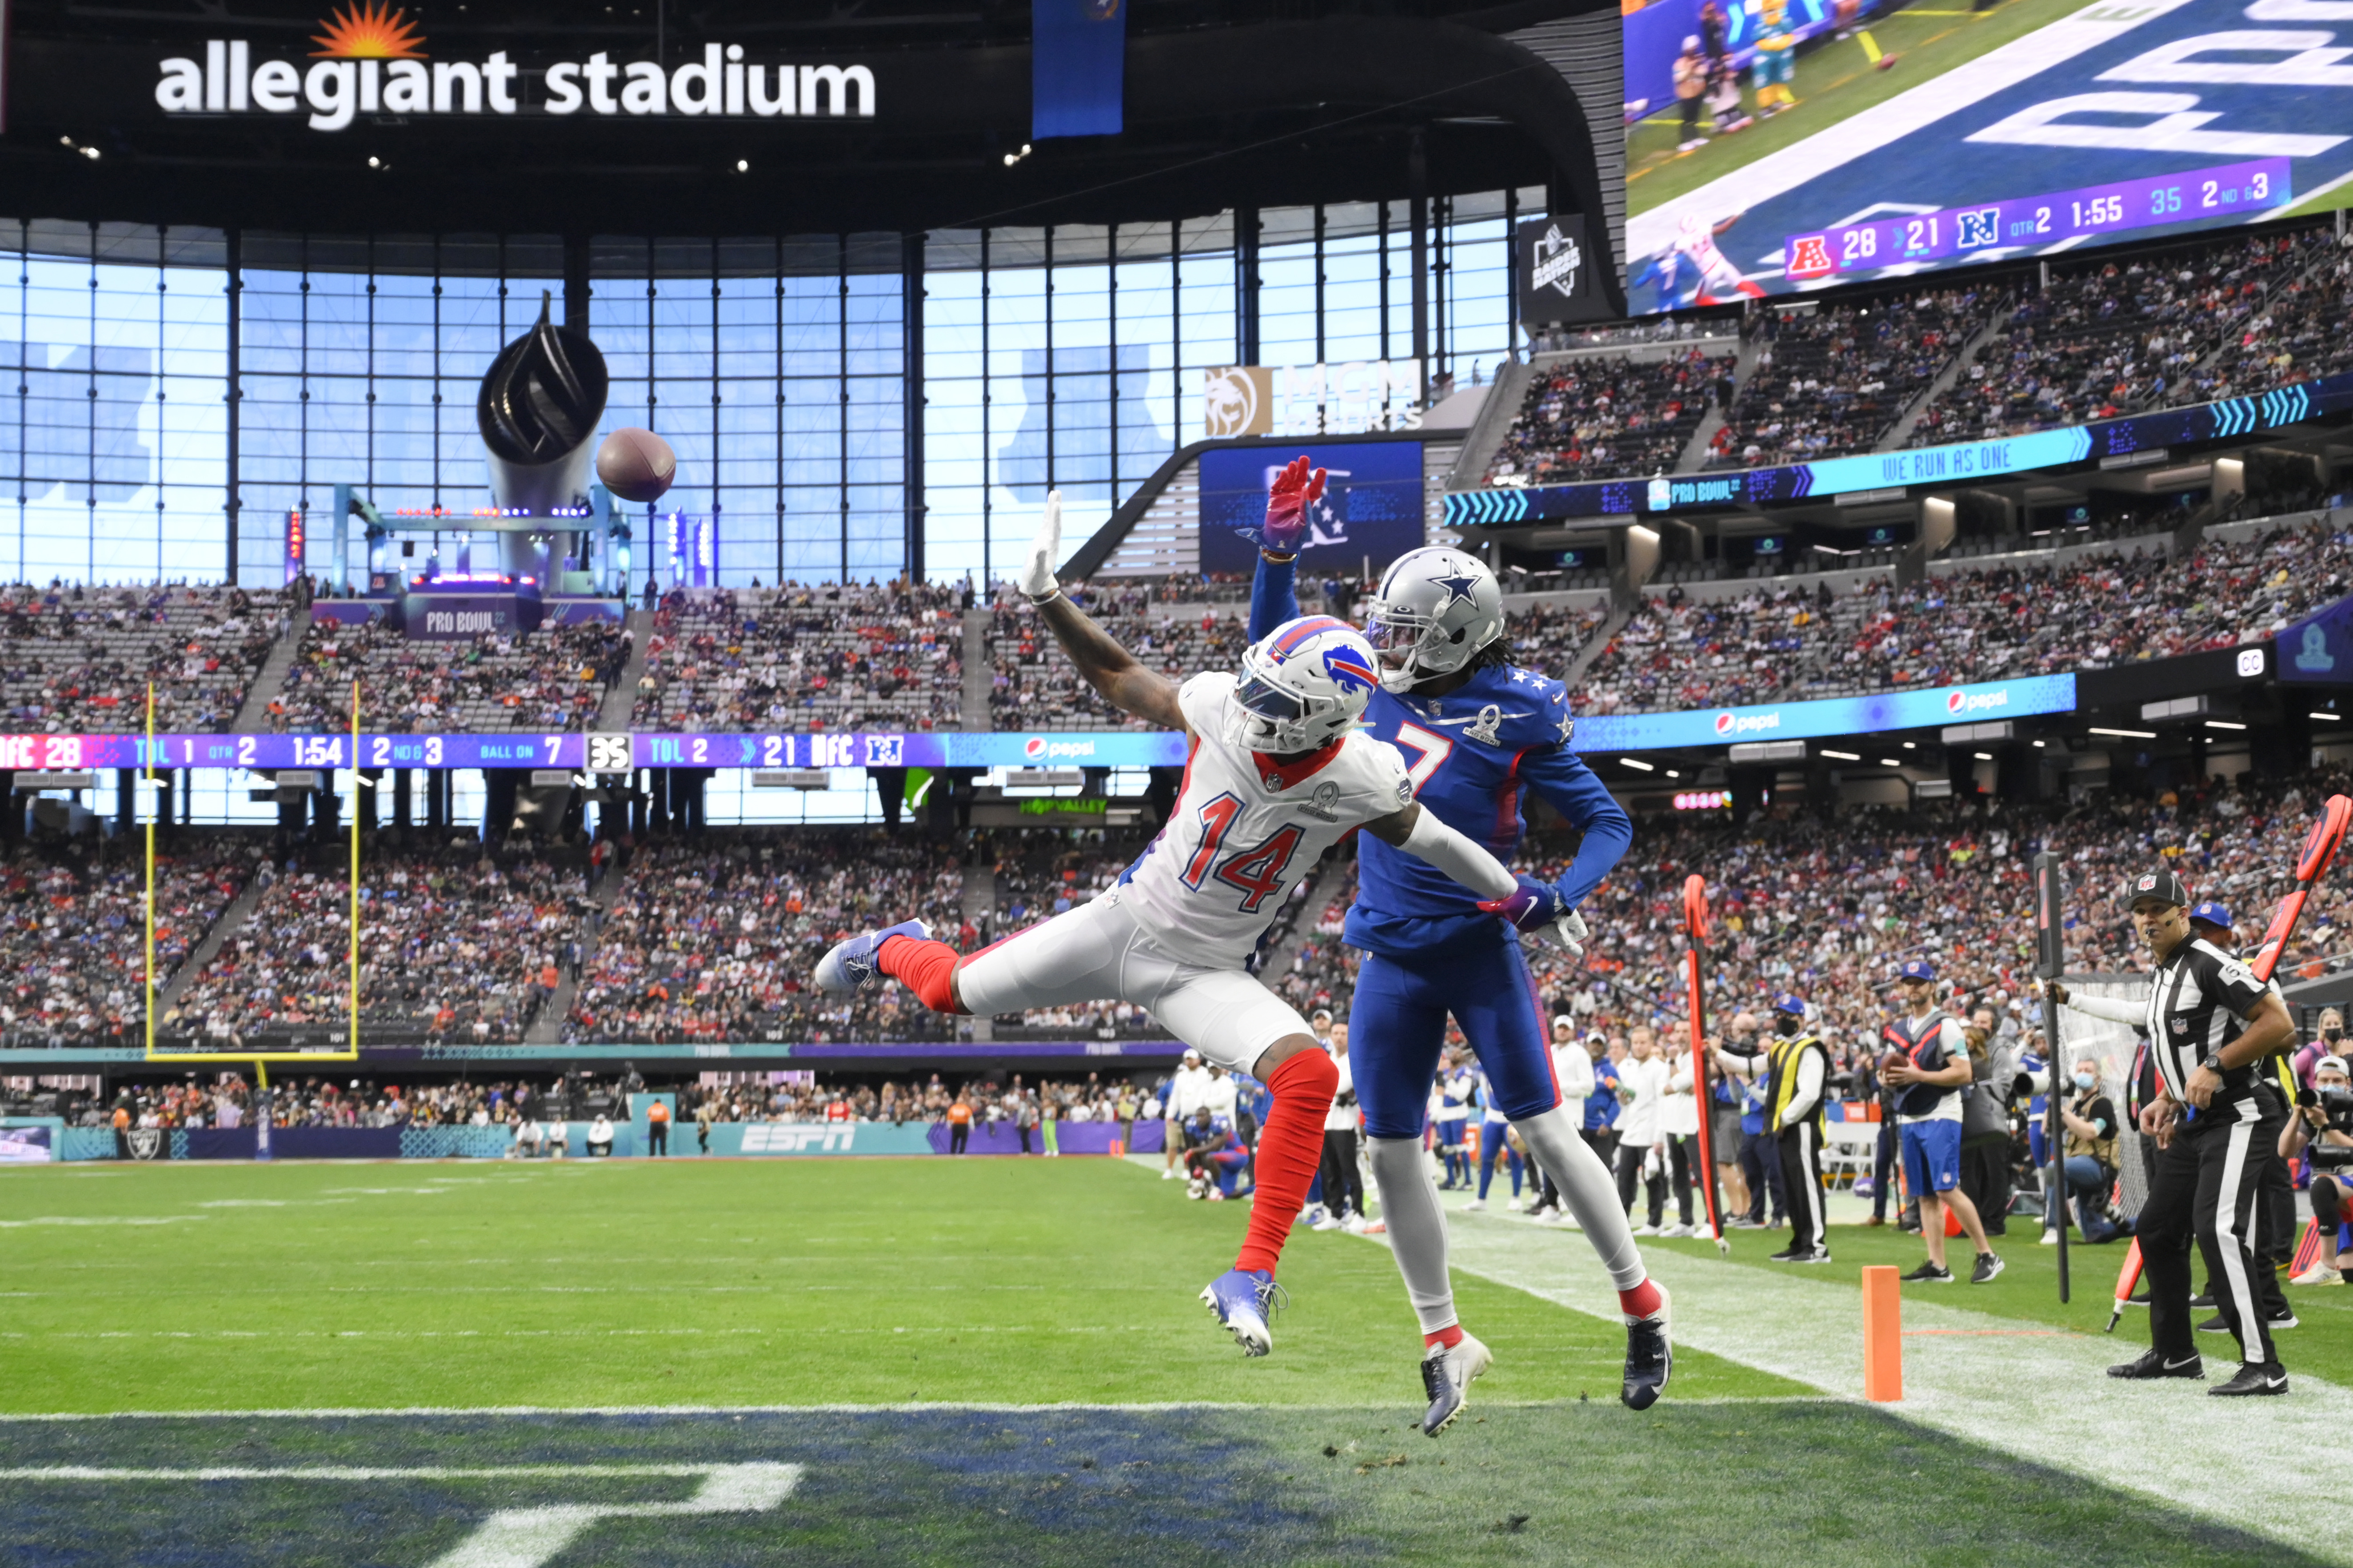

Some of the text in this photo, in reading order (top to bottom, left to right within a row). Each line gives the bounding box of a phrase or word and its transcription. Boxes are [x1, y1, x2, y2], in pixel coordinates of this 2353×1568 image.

[155, 40, 875, 132] allegiant stadium
[1843, 227, 1876, 259] 28
[1907, 218, 1938, 250] 21
[2010, 220, 2034, 237] QTR
[2035, 206, 2051, 233] 2
[2072, 195, 2122, 228] 1:55
[2151, 186, 2181, 215] 35
[2202, 180, 2218, 207] 2
[2222, 188, 2238, 203] ND
[2252, 172, 2268, 199] 3
[1283, 358, 1422, 406] MGM
[1284, 407, 1423, 435] RESORTS
[1882, 443, 2012, 482] WE RUN AS ONE
[1671, 483, 1696, 503] PRO
[1697, 480, 1734, 502] BOWL
[427, 611, 454, 633] PRO
[456, 611, 496, 632] BOWL
[2241, 654, 2260, 671] CC
[1967, 689, 2008, 713] pepsi
[1737, 712, 1780, 733] pepsi
[650, 738, 685, 763] TOL
[692, 738, 707, 763] 2
[764, 736, 795, 766] 21
[811, 734, 853, 766] NFC
[1048, 740, 1095, 758] pepsi
[1465, 728, 1498, 746] PRO BOWL
[46, 737, 81, 767] 28
[184, 739, 193, 762] 1
[209, 746, 233, 759] QTR
[238, 737, 256, 765] 2
[293, 737, 343, 765] 1:54
[372, 737, 390, 765] 2
[394, 745, 411, 758] ND
[425, 737, 443, 765] 3
[480, 746, 512, 759] BALL
[516, 745, 533, 758] ON
[544, 737, 562, 765] 7
[591, 737, 628, 768] 35
[1394, 720, 1454, 798] 7
[1300, 805, 1335, 822] PRO BOWL
[1178, 790, 1306, 914] 14
[2140, 880, 2154, 889] NFL
[329, 1031, 345, 1043] 101
[740, 1124, 856, 1151] ESPN
